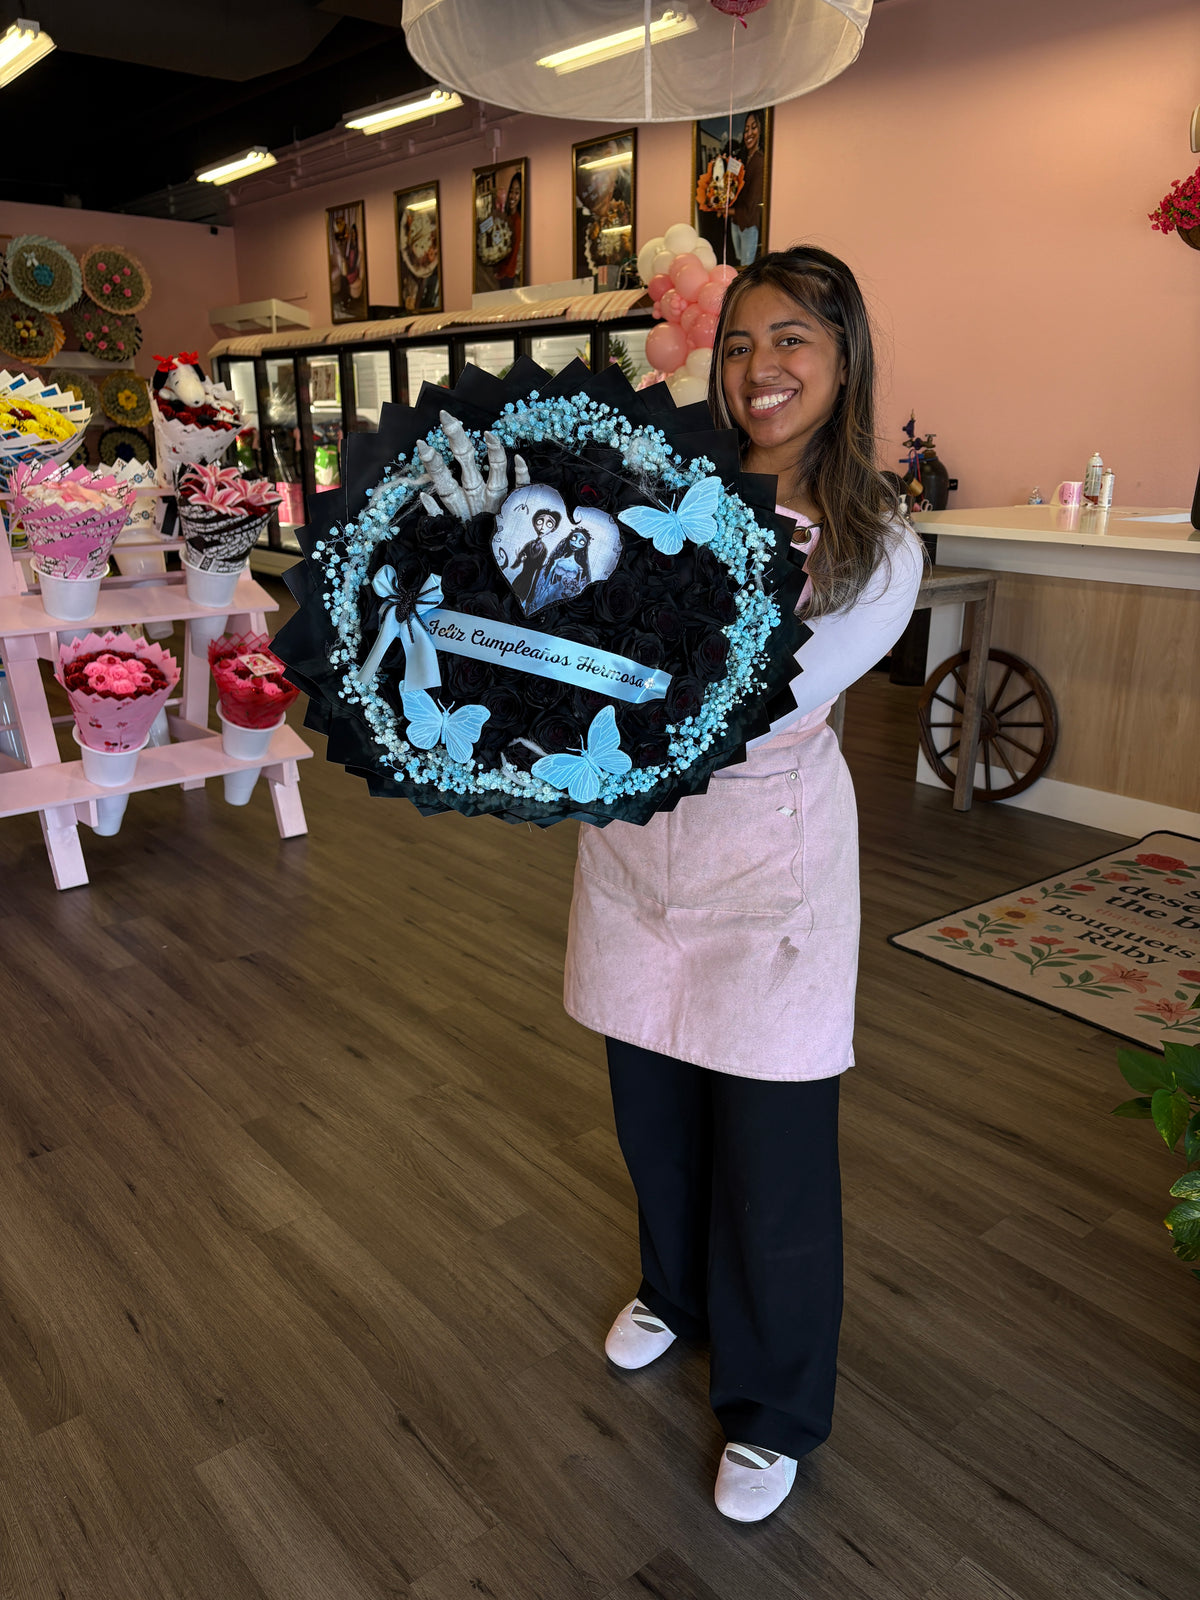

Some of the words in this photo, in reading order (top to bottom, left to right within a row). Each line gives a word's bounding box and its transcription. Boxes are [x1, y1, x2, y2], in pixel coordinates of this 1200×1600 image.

[428, 619, 467, 642] Feliz
[470, 628, 573, 667] Cumpleaños
[576, 655, 646, 688] Hermosa
[1105, 896, 1168, 919] the
[1043, 904, 1196, 959] Bouquets
[1074, 930, 1168, 964] Ruby
